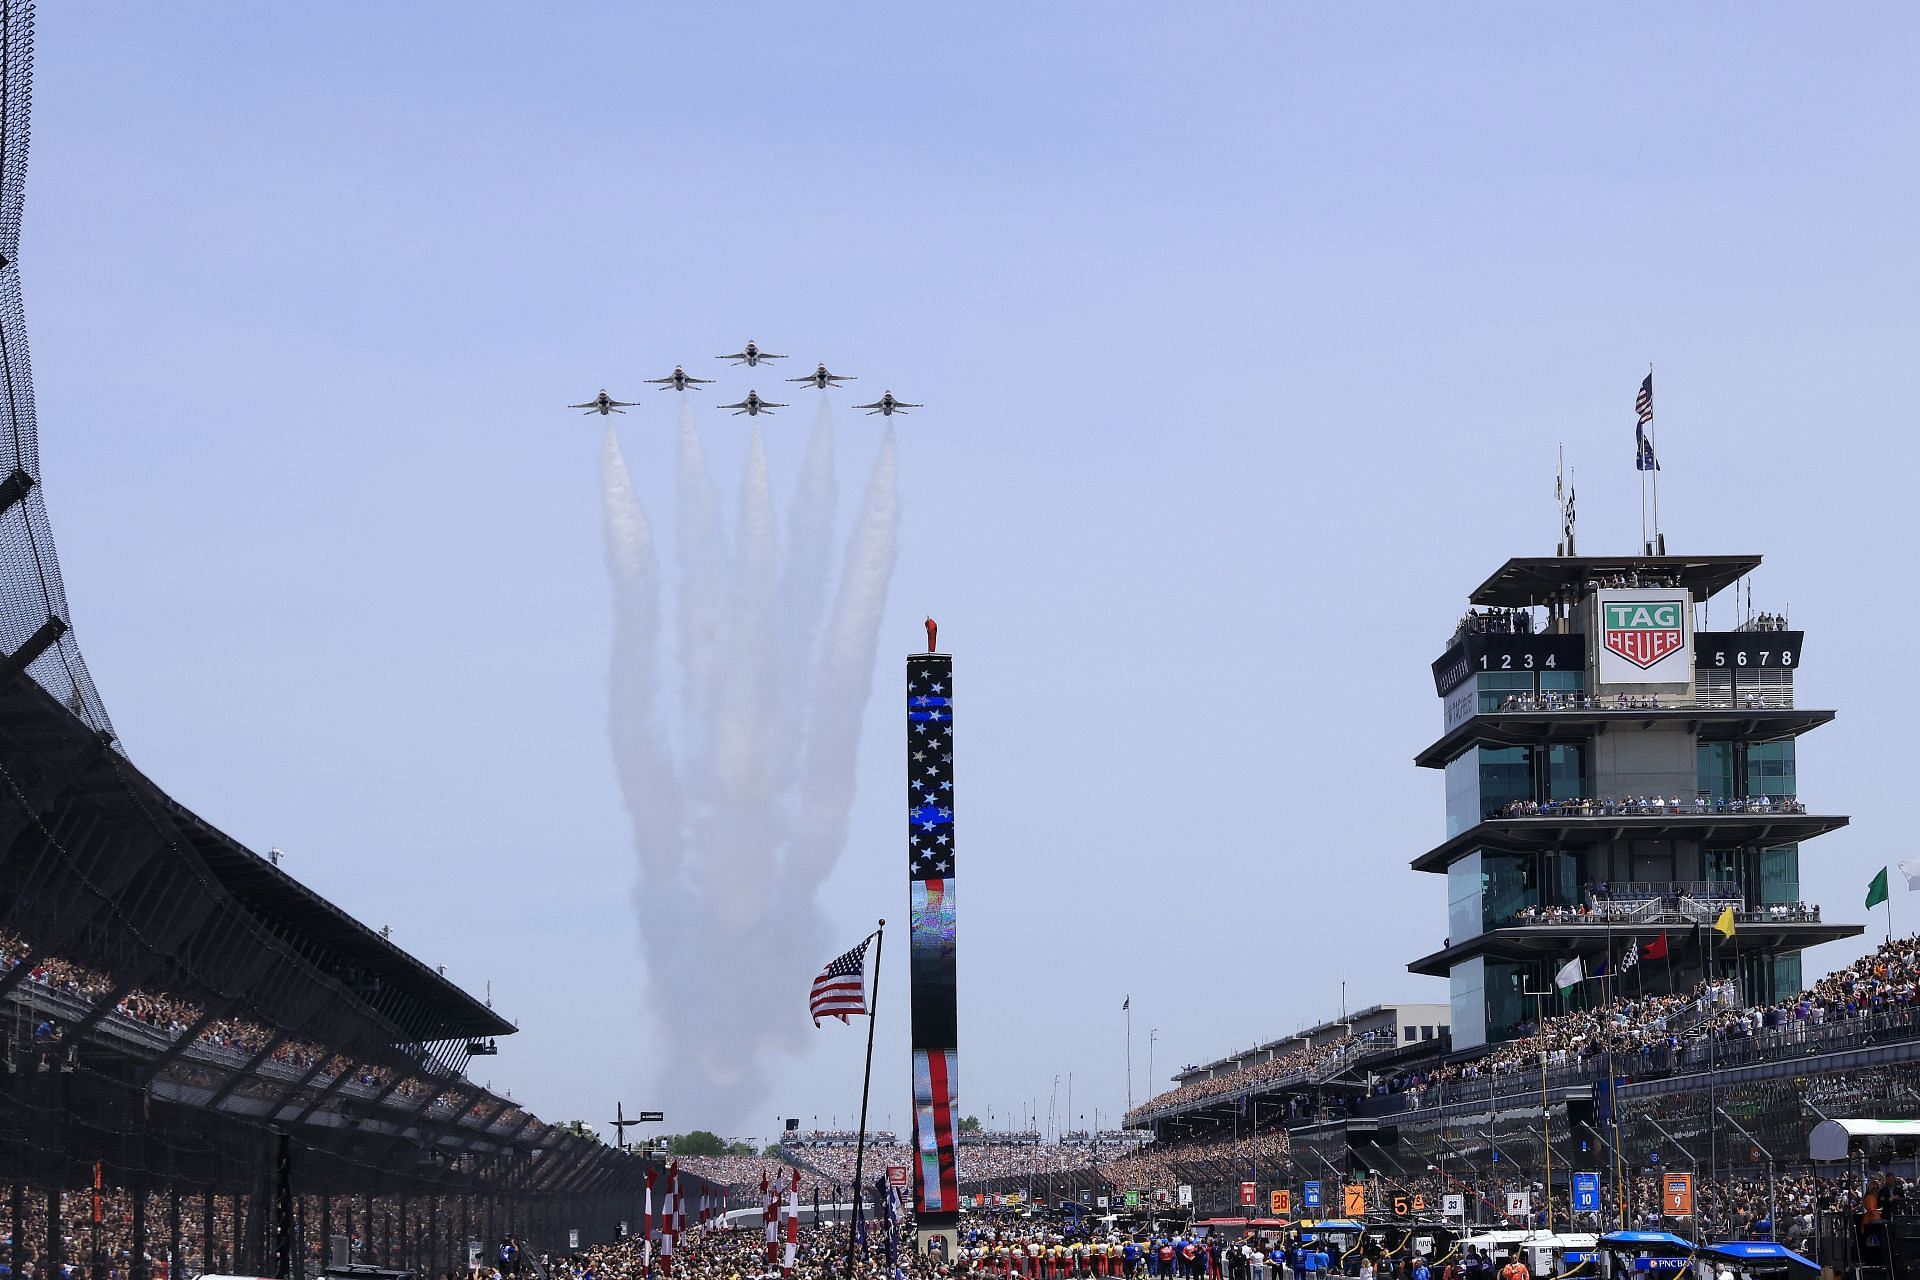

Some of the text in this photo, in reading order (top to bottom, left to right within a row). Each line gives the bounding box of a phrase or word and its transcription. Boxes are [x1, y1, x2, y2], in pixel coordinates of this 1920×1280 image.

[1611, 607, 1674, 626] TAG
[1610, 632, 1678, 662] HEUER
[1480, 654, 1556, 669] 1 2 3 4
[1716, 651, 1792, 666] 5 6 7 8
[1274, 1195, 1287, 1209] 28
[1349, 1192, 1360, 1209] 7
[1394, 1197, 1408, 1214] 5
[1448, 1201, 1457, 1210] 33
[1512, 1199, 1523, 1209] 21
[1582, 1194, 1591, 1204] 10
[1675, 1196, 1681, 1208] 9
